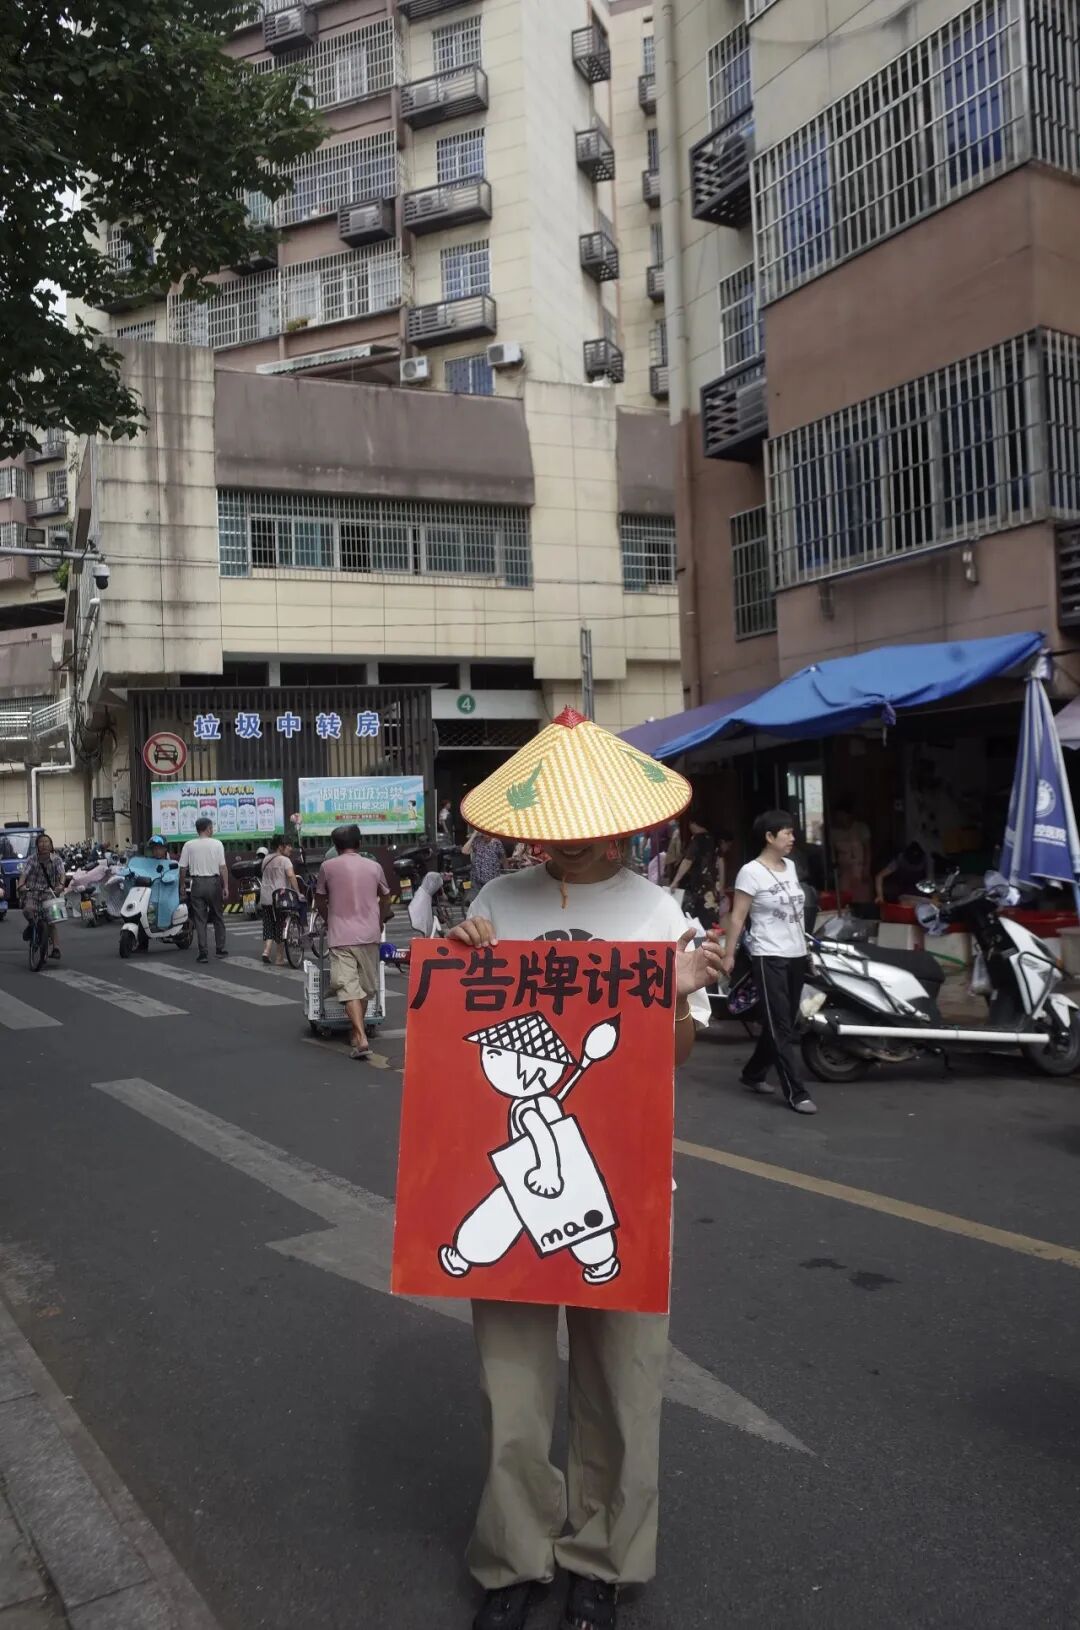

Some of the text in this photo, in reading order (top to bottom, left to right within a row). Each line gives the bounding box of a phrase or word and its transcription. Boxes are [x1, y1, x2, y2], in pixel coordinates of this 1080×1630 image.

[461, 696, 472, 711] 4
[194, 711, 380, 739] 垃圾中转房
[410, 946, 674, 1015] 广告牌计划
